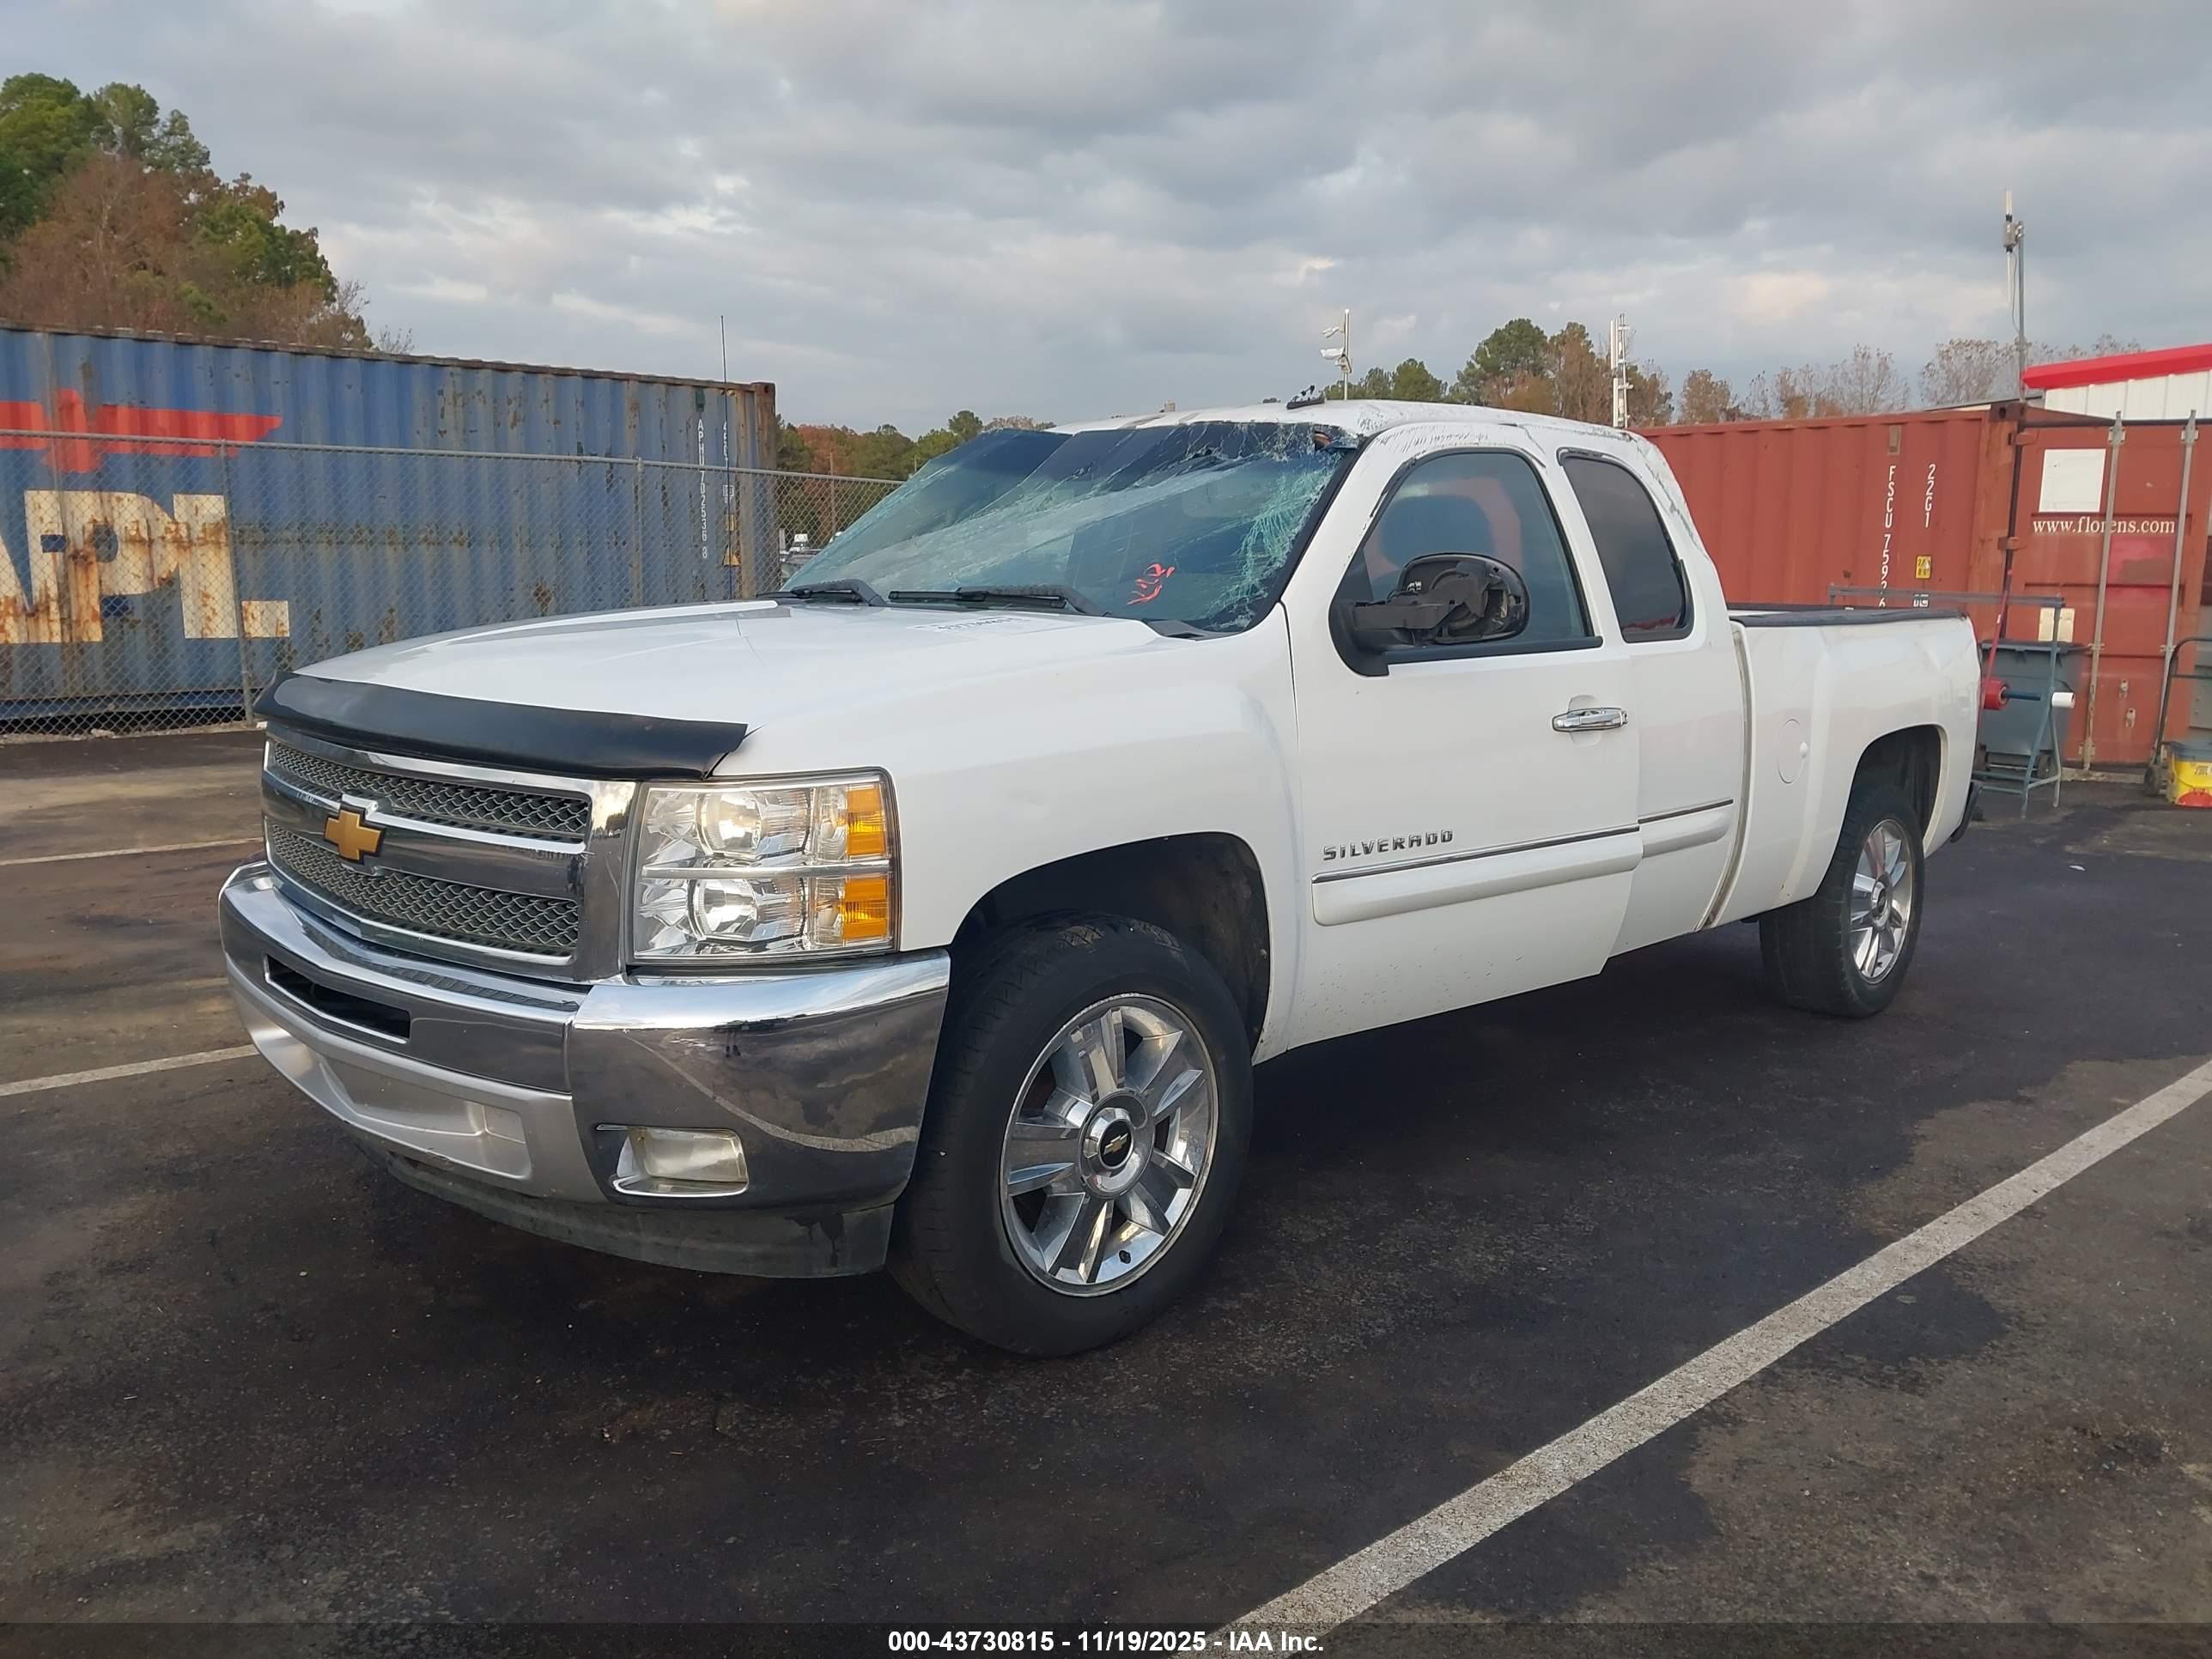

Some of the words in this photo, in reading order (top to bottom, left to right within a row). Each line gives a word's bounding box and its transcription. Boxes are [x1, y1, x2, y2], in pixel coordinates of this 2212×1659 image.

[1885, 465, 1897, 529] FSCU
[1925, 463, 1936, 528] 22G1
[2033, 516, 2176, 534] www.florens.com
[1322, 829, 1454, 860] SILVERADO
